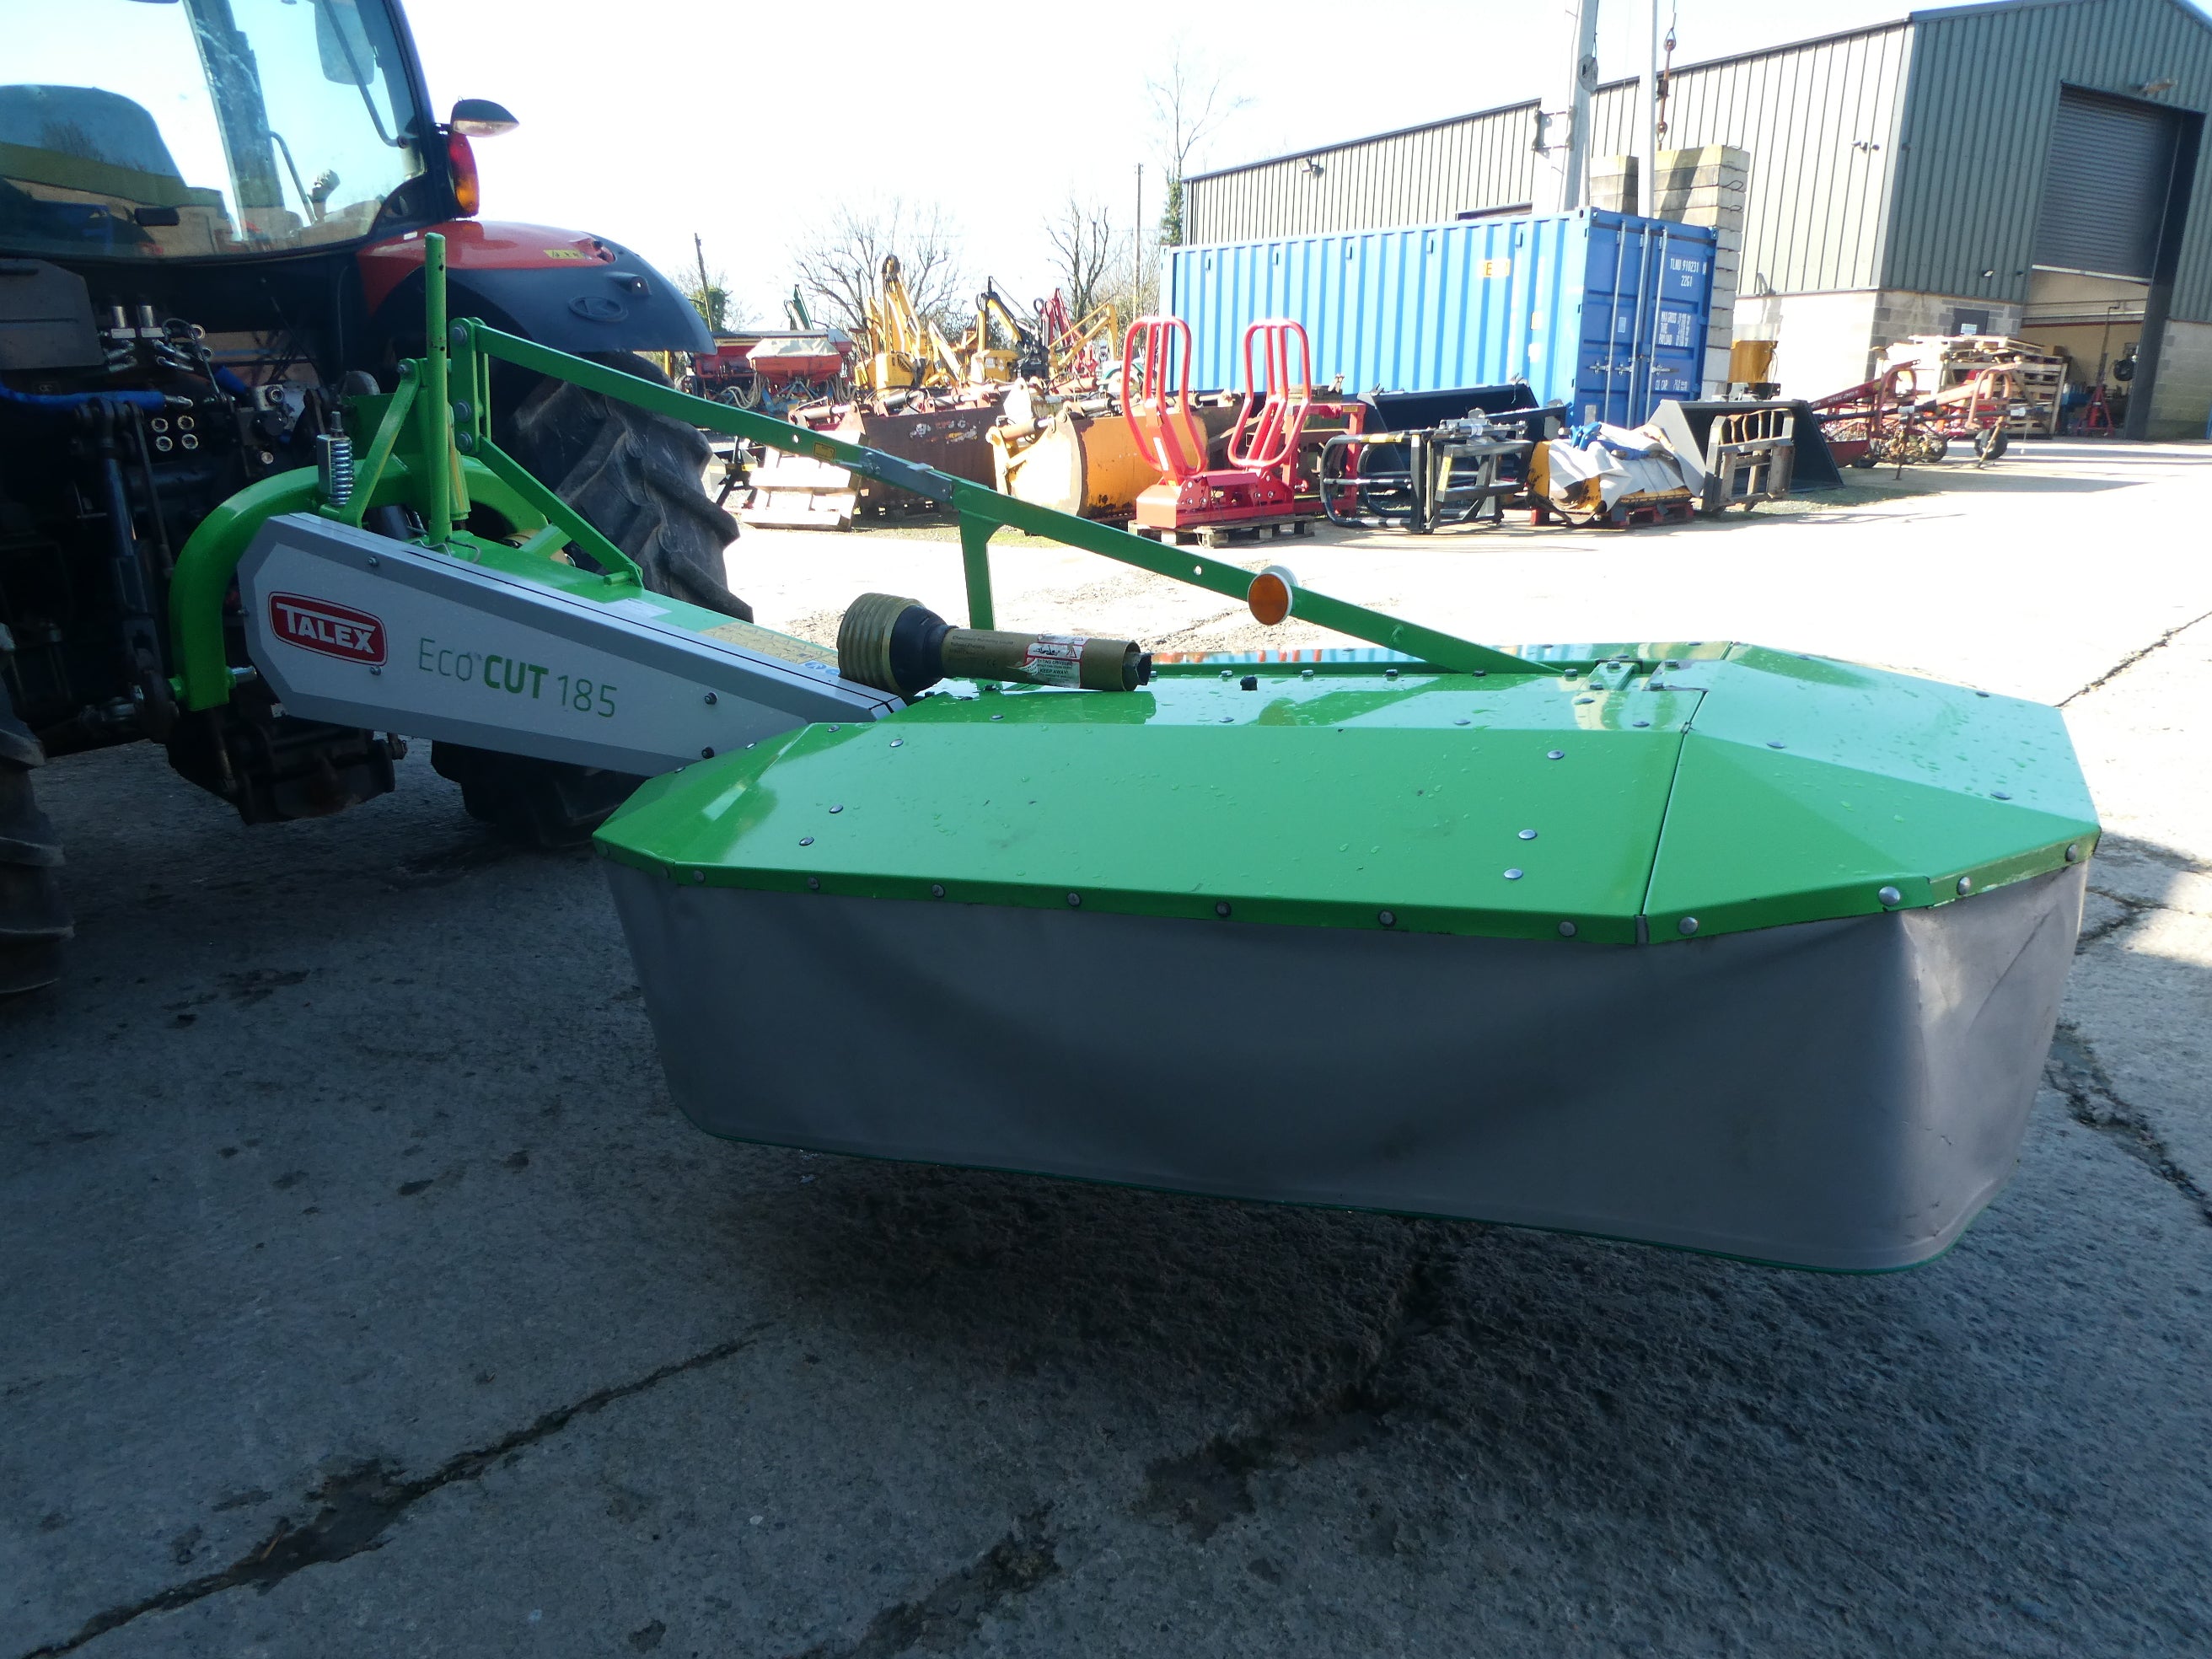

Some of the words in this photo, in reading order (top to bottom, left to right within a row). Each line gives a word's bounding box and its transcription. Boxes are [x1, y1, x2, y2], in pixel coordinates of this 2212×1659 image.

[1680, 275, 1693, 287] 22G1
[276, 602, 376, 654] TALEX
[484, 654, 549, 699] CUT
[557, 675, 617, 718] 185
